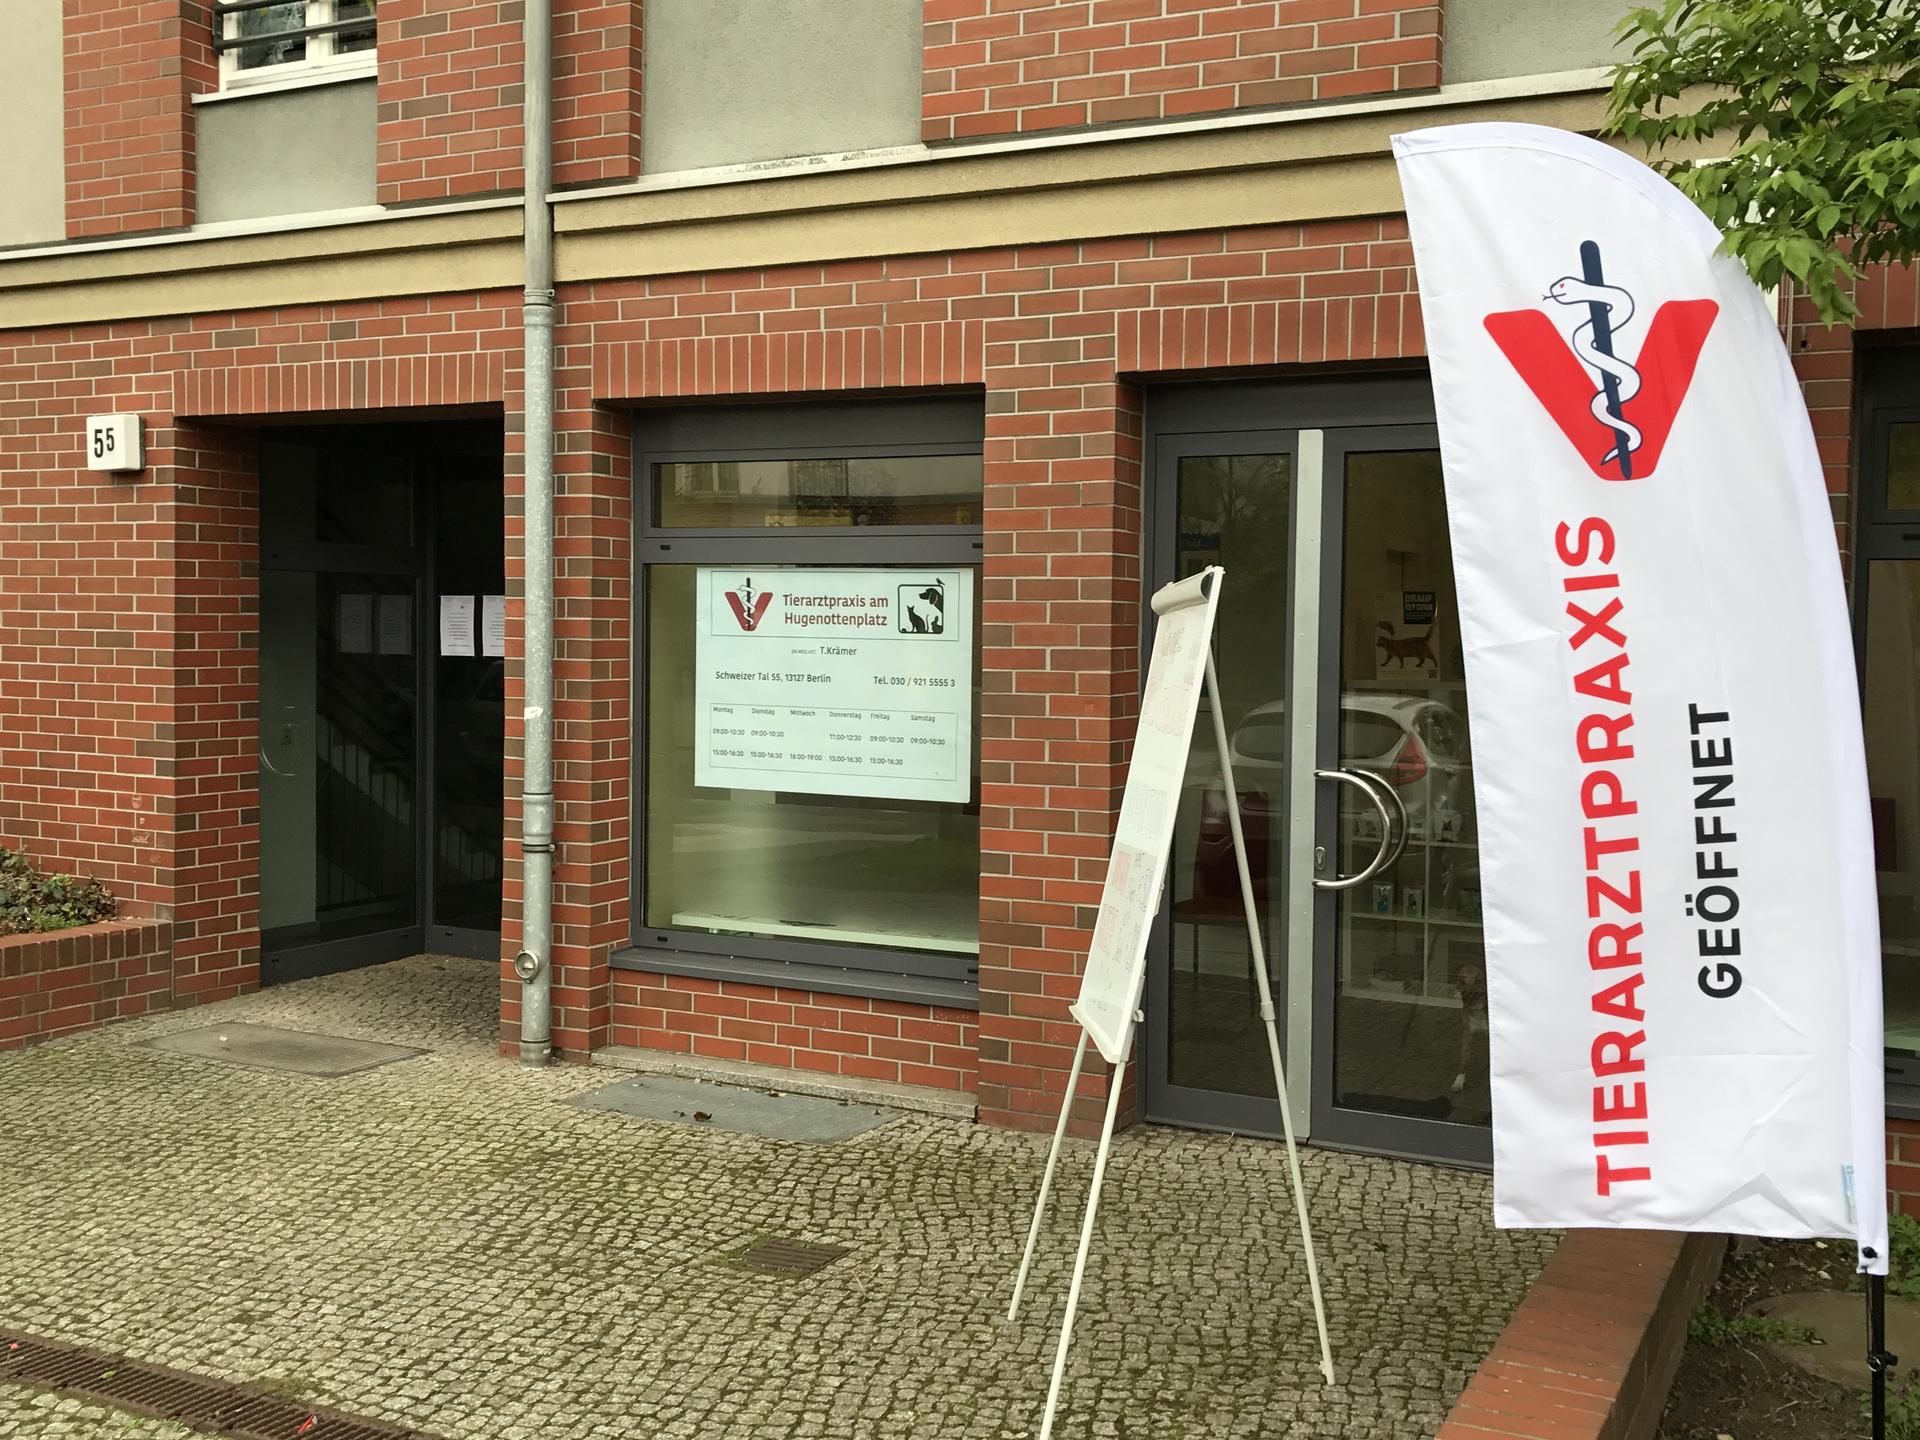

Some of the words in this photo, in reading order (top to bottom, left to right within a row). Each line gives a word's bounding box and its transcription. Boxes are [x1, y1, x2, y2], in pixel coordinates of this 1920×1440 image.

[94, 427, 115, 458] 55
[783, 593, 866, 609] Tierarztpraxis
[869, 597, 889, 608] am
[784, 612, 888, 628] Hugenottenplatz
[820, 646, 857, 656] T.Krämer
[715, 671, 756, 681] Schweizer
[758, 672, 770, 681] Tal
[771, 673, 783, 682] 55,
[785, 674, 805, 682] 13127
[807, 674, 831, 683] Berlin
[873, 675, 888, 685] Tel.
[890, 676, 905, 686] 030
[913, 677, 926, 686] 921
[929, 678, 949, 687] 5555
[950, 679, 956, 687] 3
[713, 706, 734, 714] Montag
[751, 708, 775, 716] Dienstag
[790, 709, 816, 717] Mittwoch
[829, 711, 862, 720] Donnerstag
[870, 713, 890, 721] Freitag
[910, 714, 936, 723] Samstag
[1555, 515, 1652, 1197] TIERARZTPRAXIS
[1685, 703, 1743, 999] GEÖFFNET
